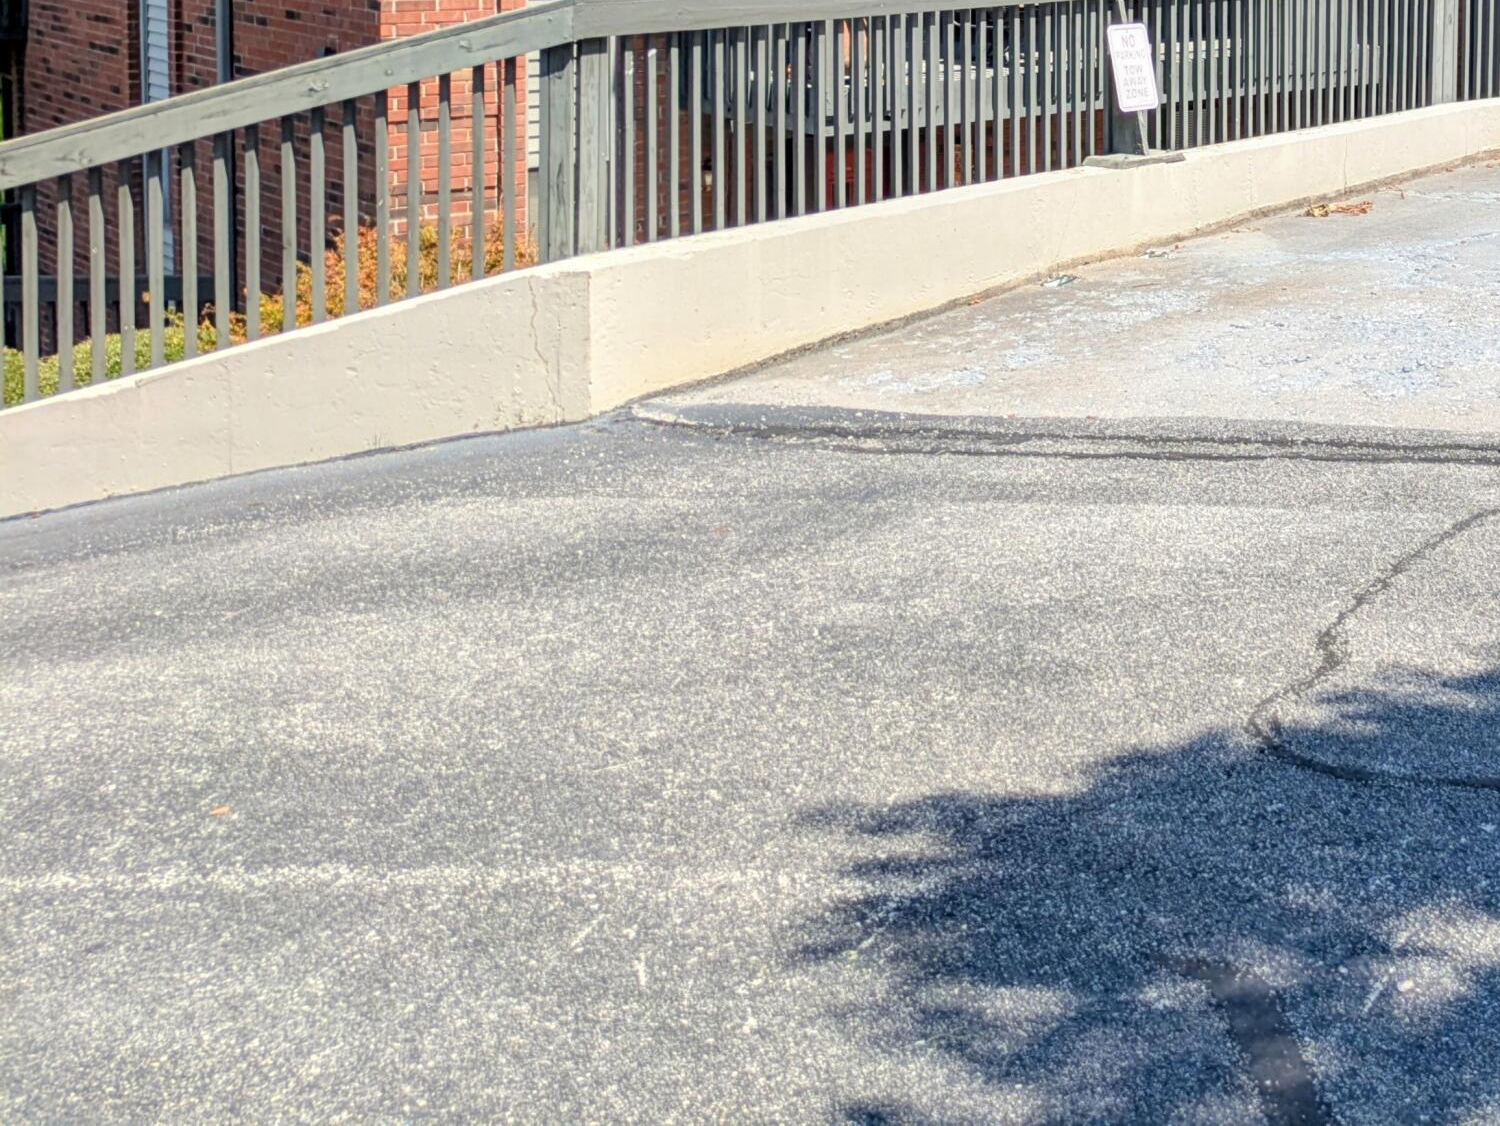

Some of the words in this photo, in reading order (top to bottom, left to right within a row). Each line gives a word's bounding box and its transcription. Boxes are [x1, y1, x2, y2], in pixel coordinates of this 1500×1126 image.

[1121, 33, 1136, 48] NO
[1123, 65, 1144, 75] TOW
[1123, 76, 1147, 87] AWAY
[1125, 87, 1150, 99] ZONE
